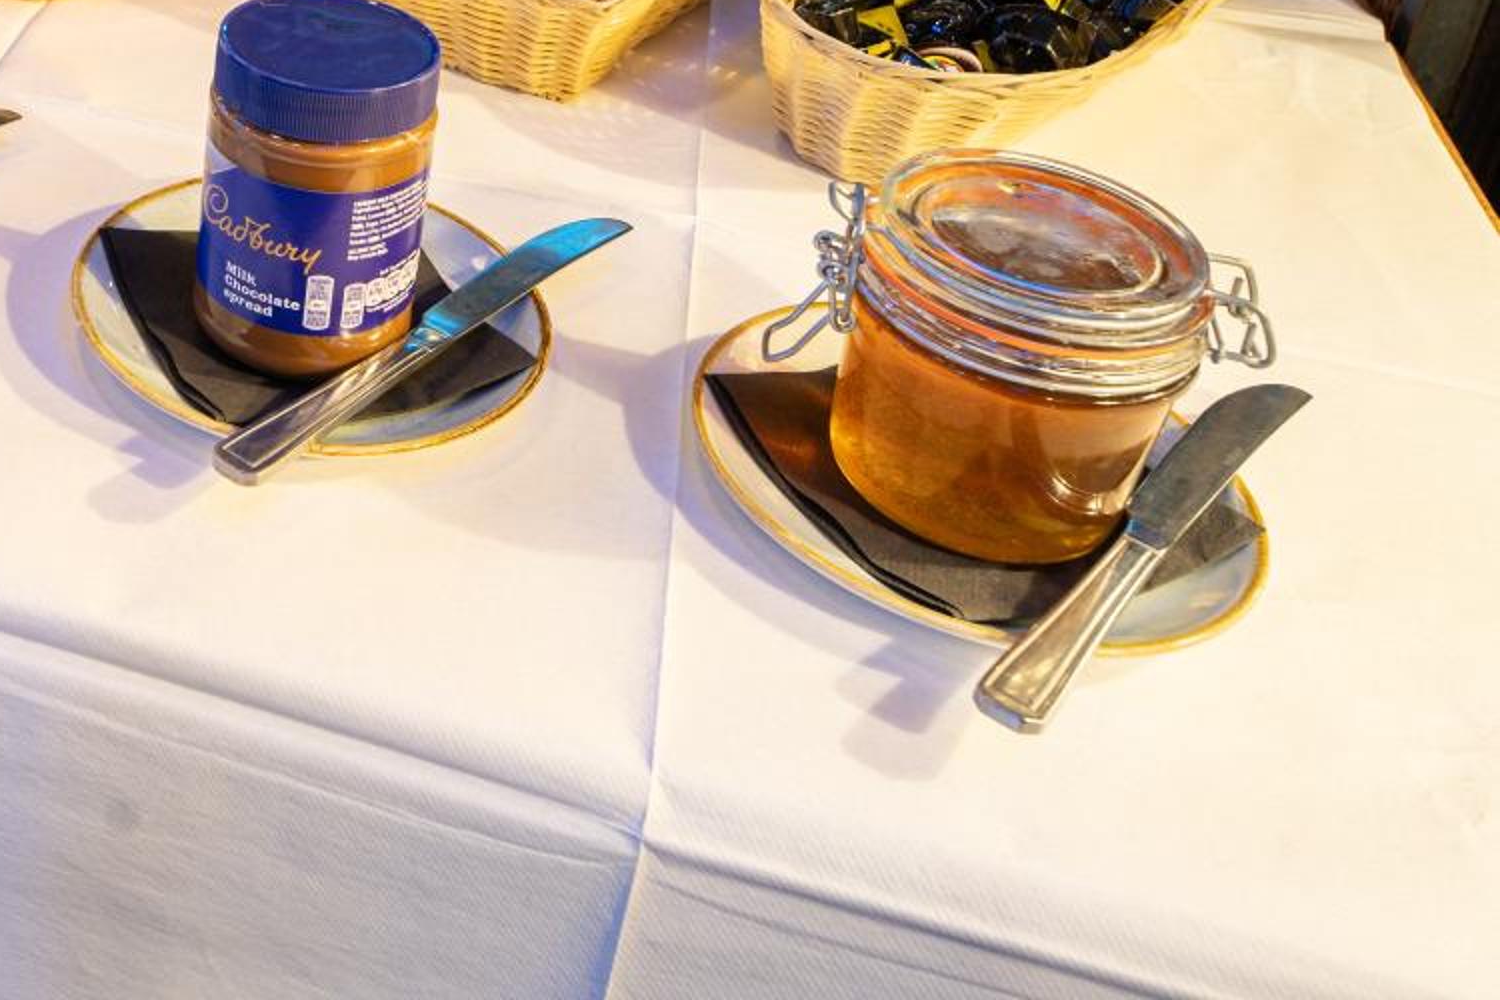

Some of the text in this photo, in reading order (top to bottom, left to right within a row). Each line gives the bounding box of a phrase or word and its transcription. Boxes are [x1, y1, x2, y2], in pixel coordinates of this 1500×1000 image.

[203, 183, 324, 275] Cadbury
[225, 260, 258, 287] Milk
[222, 287, 274, 318] spread
[223, 273, 302, 311] Chocolate
